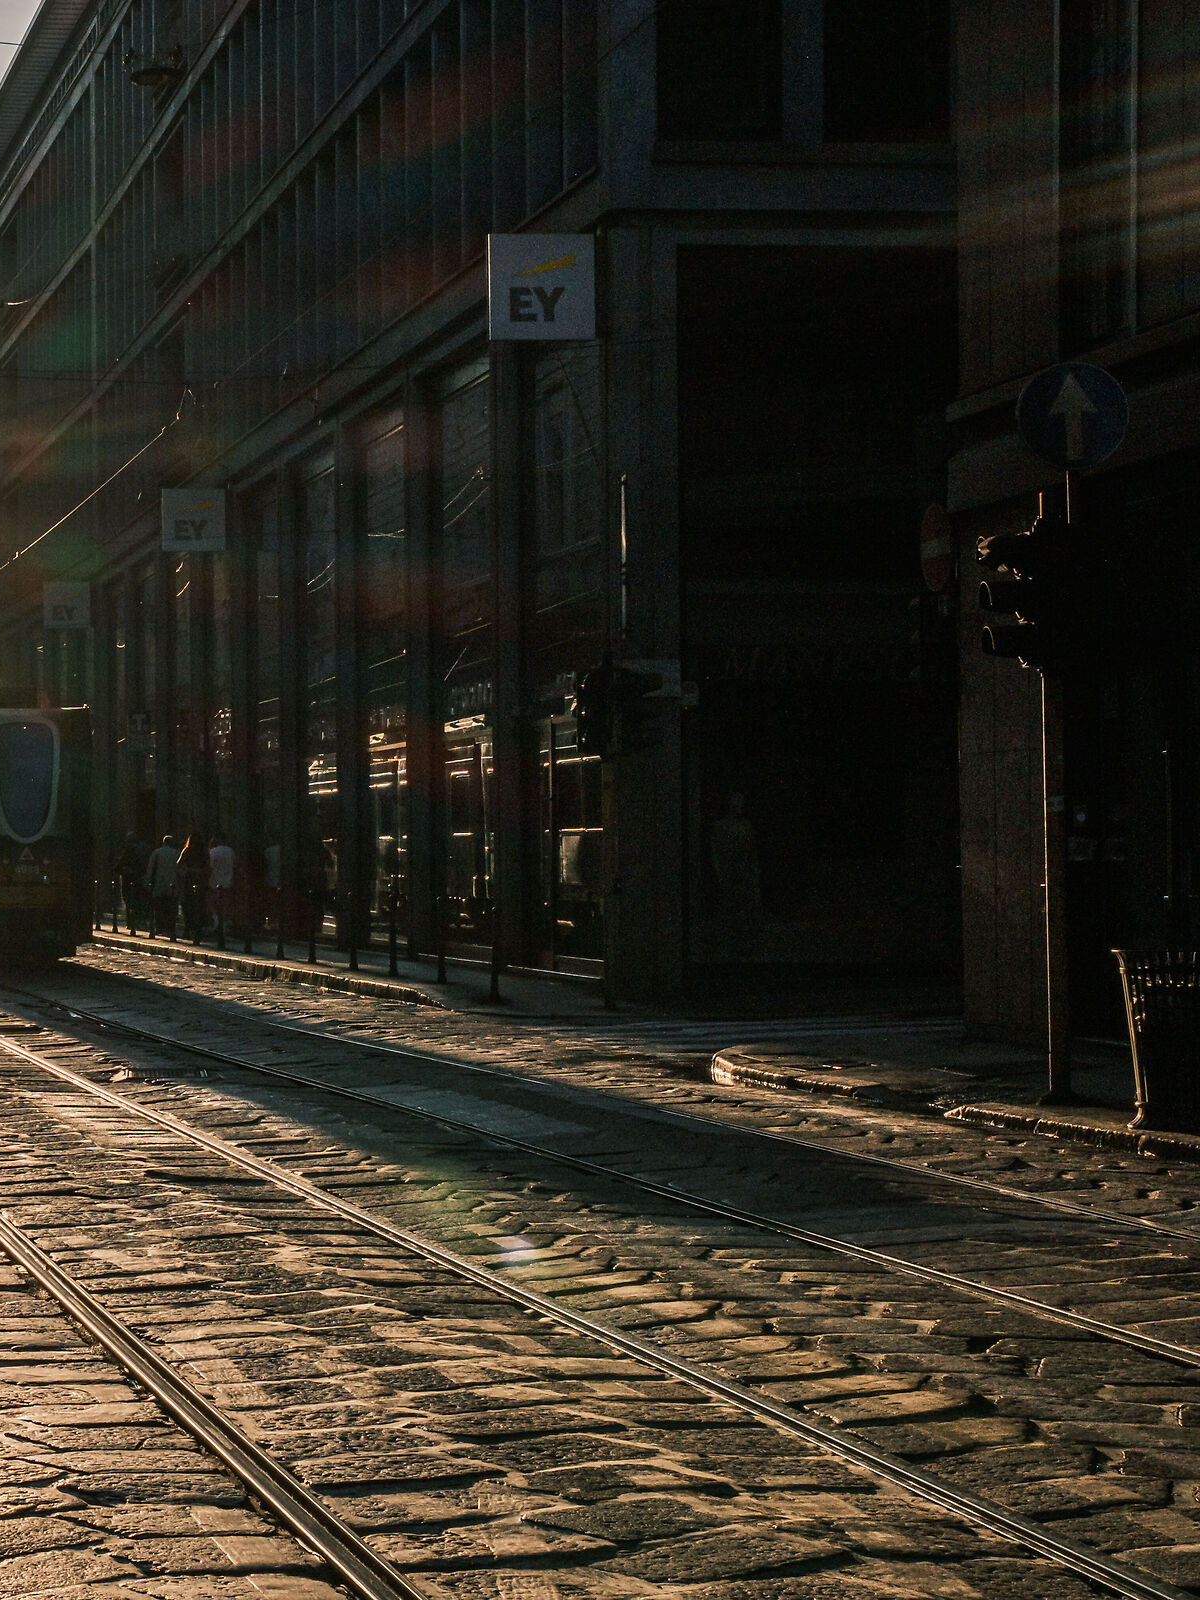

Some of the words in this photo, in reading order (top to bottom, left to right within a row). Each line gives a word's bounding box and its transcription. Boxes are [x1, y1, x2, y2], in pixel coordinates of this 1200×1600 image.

[509, 287, 565, 322] EY
[175, 519, 208, 541] EY
[52, 604, 77, 621] EY
